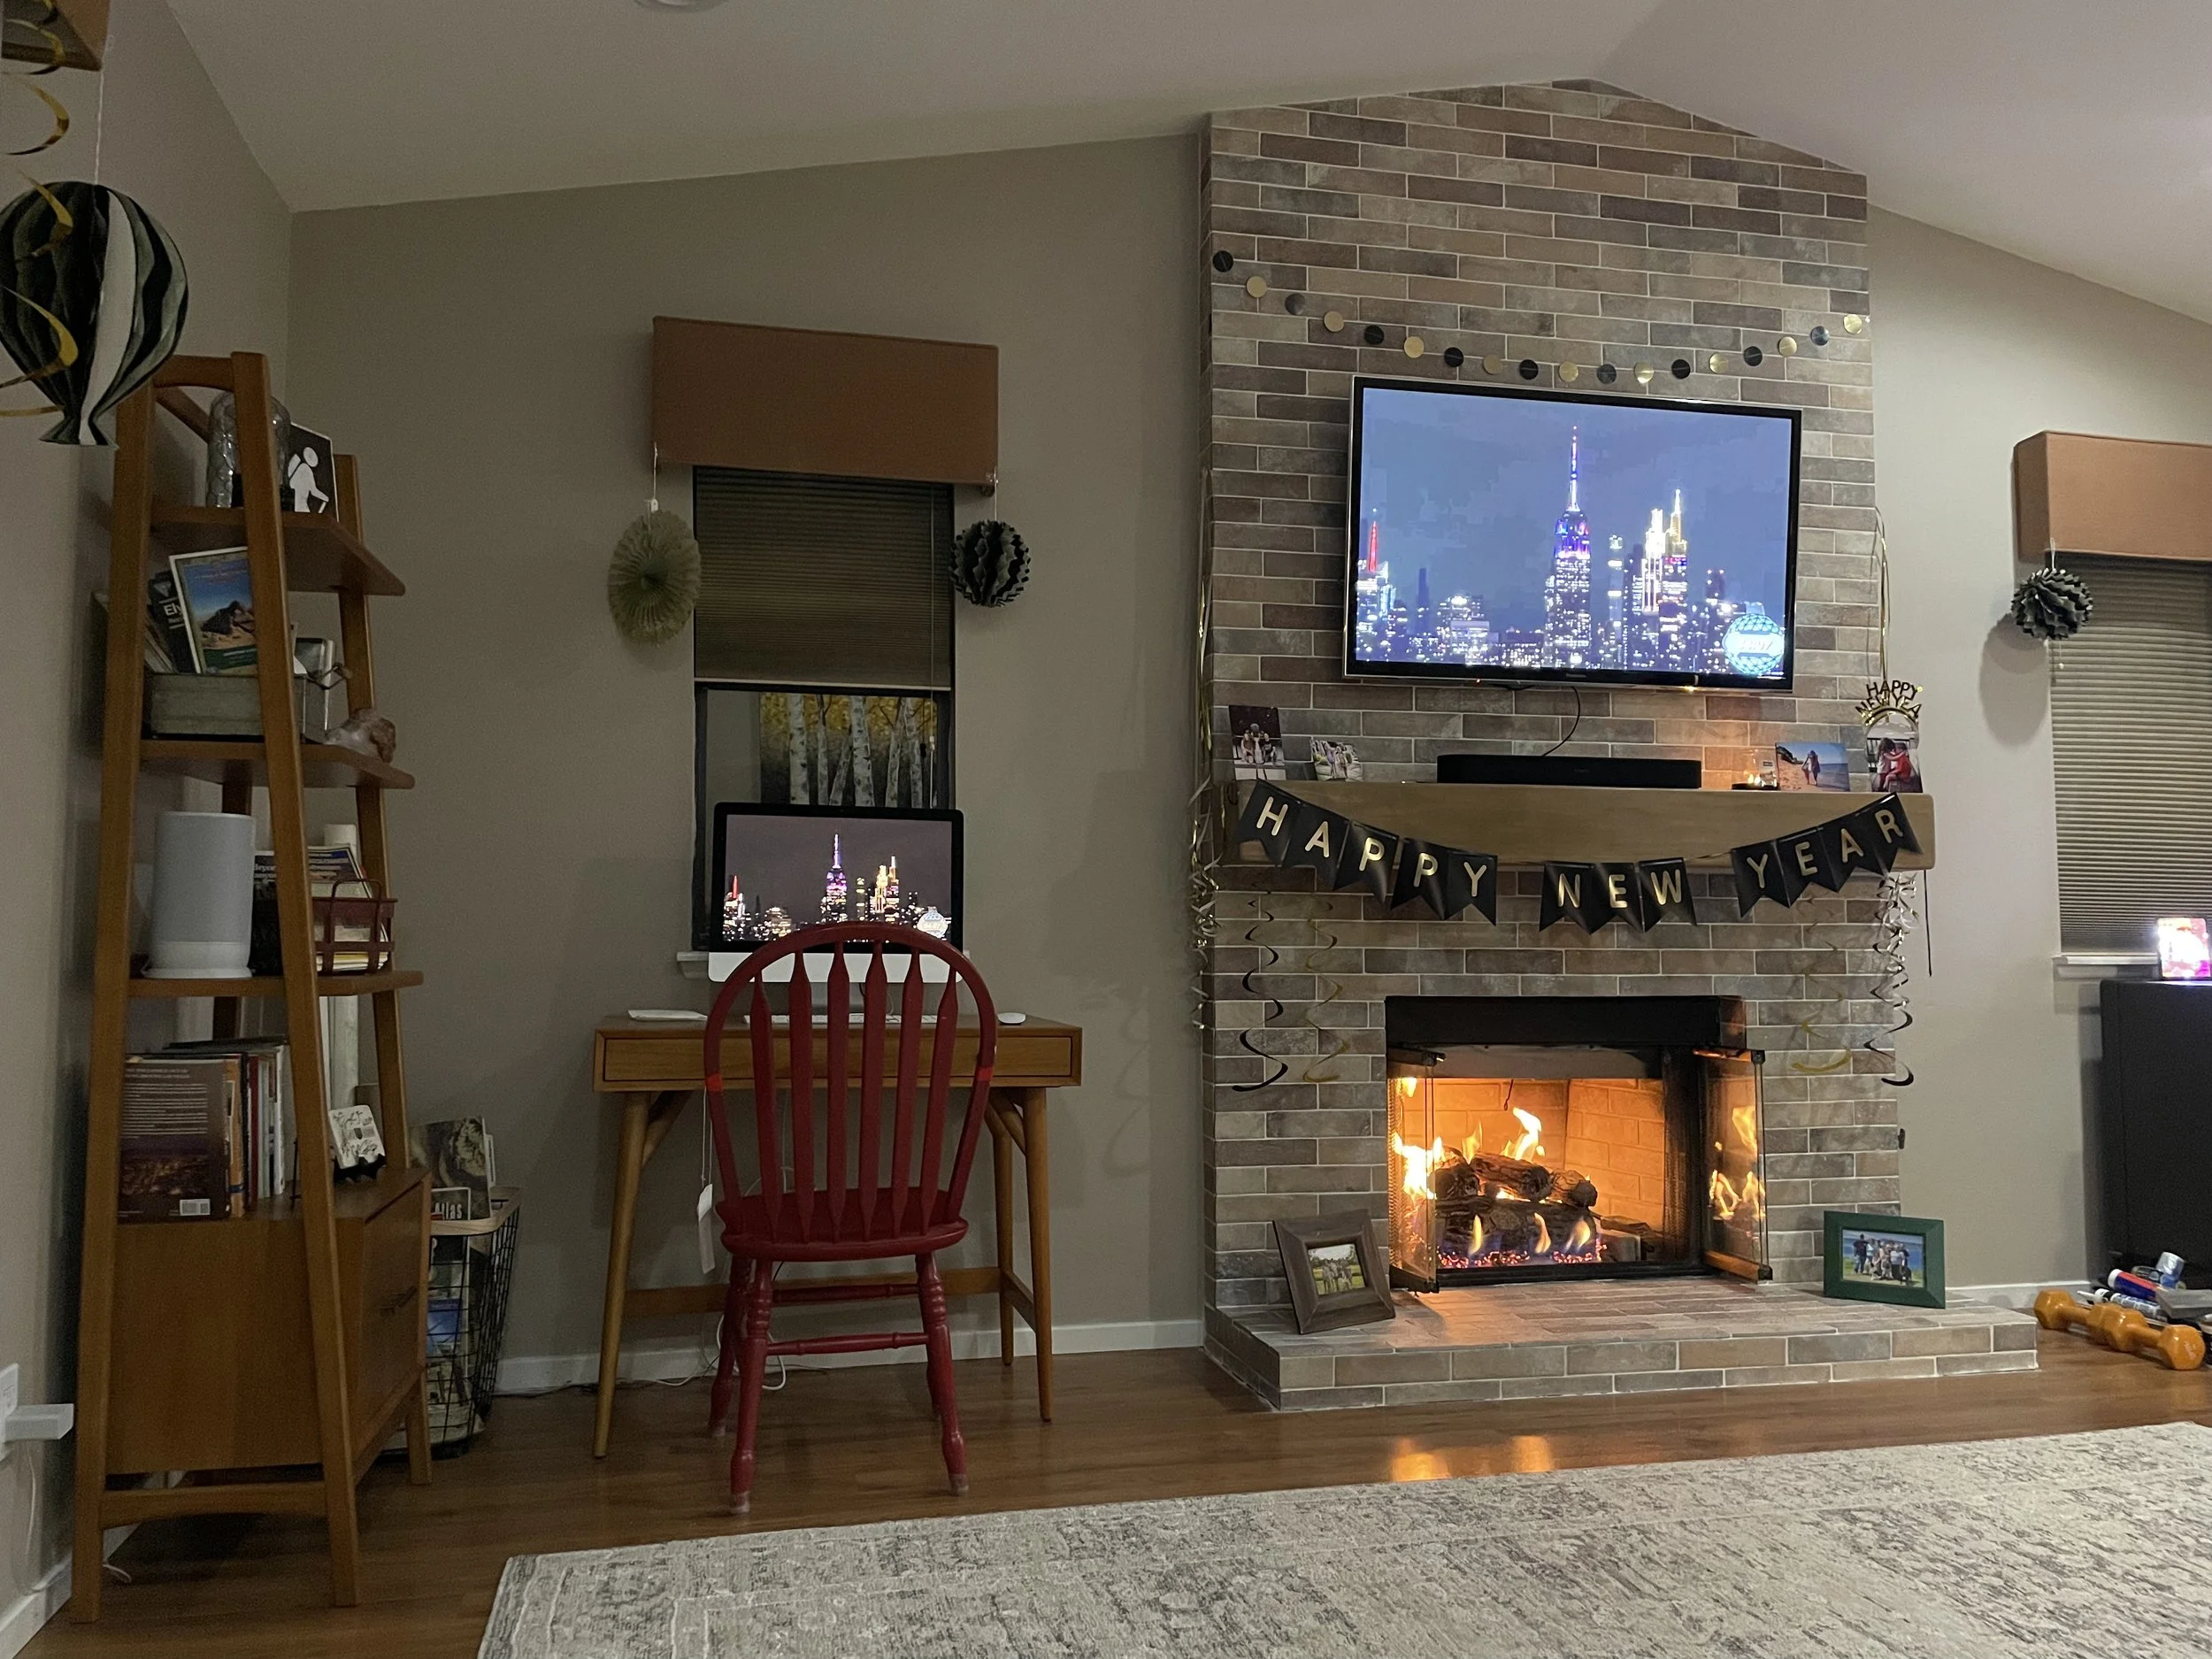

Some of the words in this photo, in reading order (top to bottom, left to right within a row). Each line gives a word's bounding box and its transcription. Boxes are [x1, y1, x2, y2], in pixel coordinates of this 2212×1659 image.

[1866, 680, 1918, 701] HAPPY
[1892, 694, 1923, 718] YEA
[1256, 796, 1488, 898] HAPPY
[1557, 870, 1681, 909] NEW
[1746, 809, 1903, 888] YEAR
